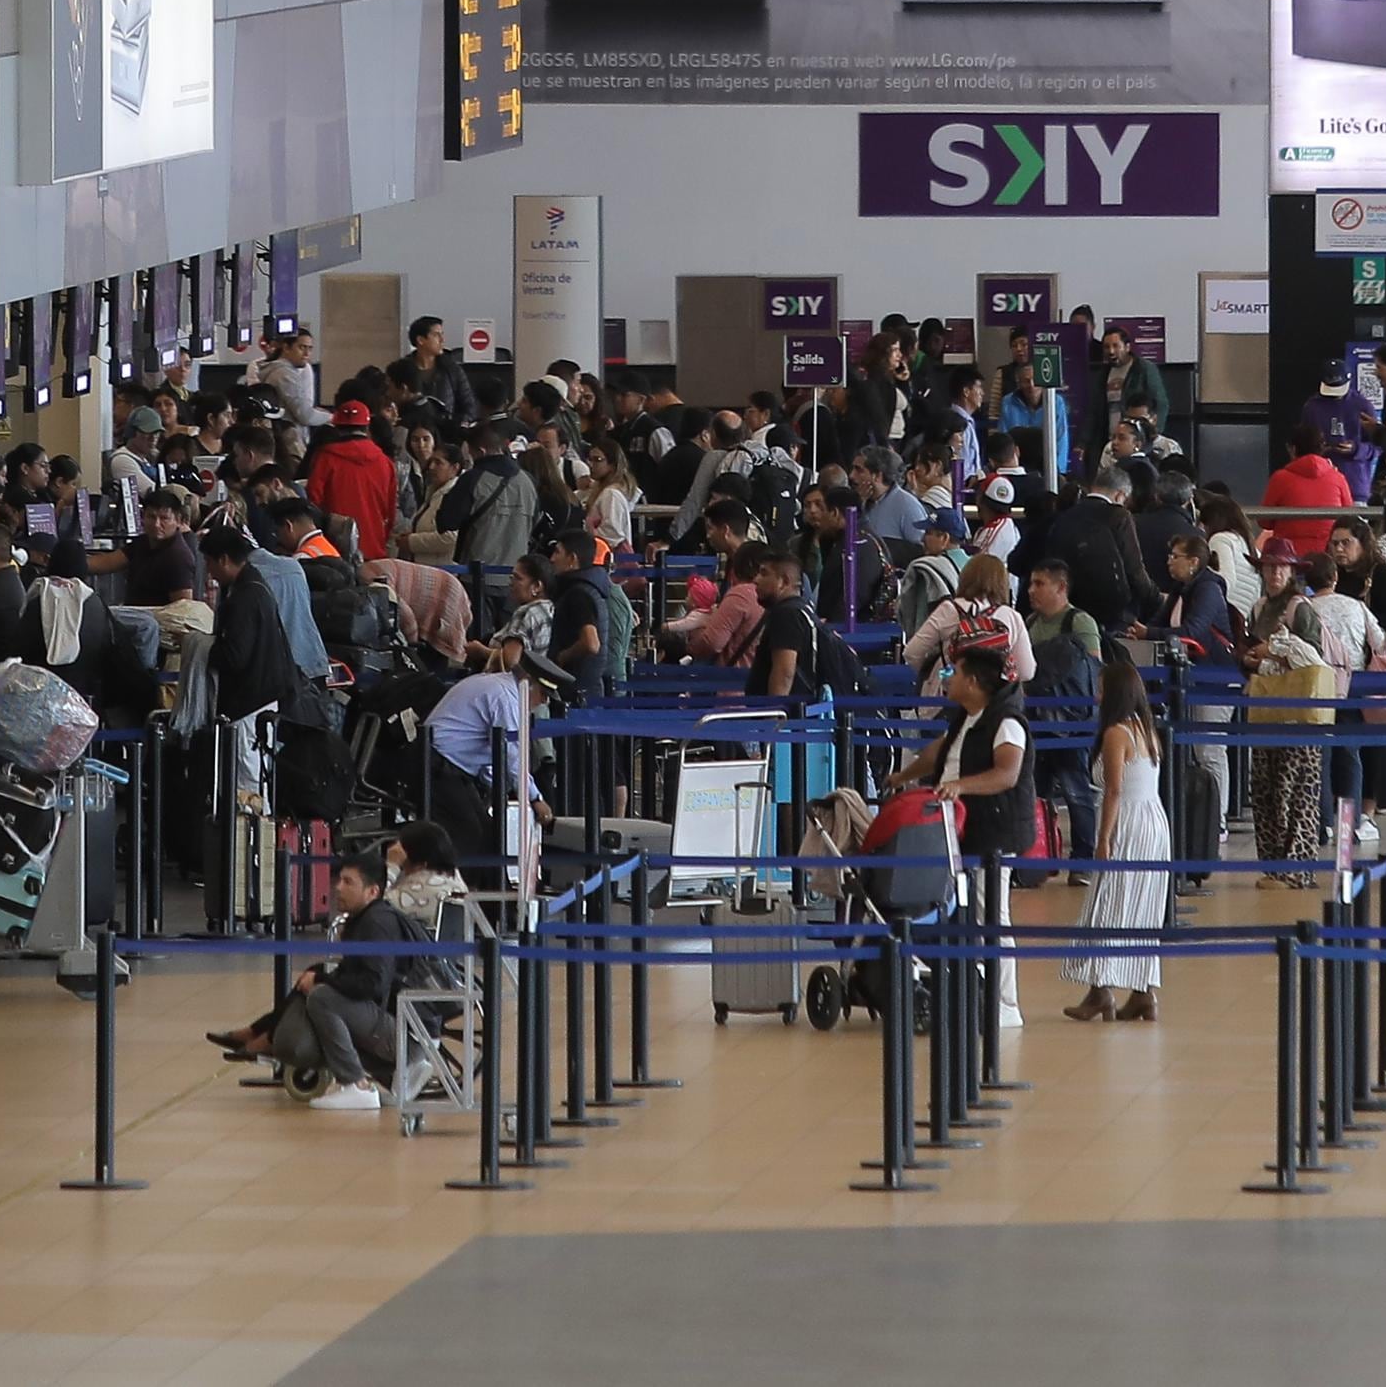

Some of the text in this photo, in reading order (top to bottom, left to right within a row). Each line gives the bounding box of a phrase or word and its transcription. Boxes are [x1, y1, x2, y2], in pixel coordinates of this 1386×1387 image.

[767, 57, 784, 68] en
[790, 56, 849, 68] nuestra
[854, 53, 888, 68] web
[890, 53, 1016, 71] www.LG.com/pe
[547, 78, 564, 89] se
[568, 76, 641, 89] muestran
[646, 78, 664, 89] en
[669, 74, 690, 89] las
[696, 74, 769, 92] imágenes
[774, 74, 831, 93] pueden
[836, 75, 880, 89] variar
[884, 74, 930, 93] según
[935, 74, 948, 89] el
[954, 74, 1014, 91] modelo,
[1037, 74, 1086, 93] región
[1092, 78, 1102, 89] o
[1106, 74, 1120, 89] el
[928, 123, 1151, 207] SKY
[530, 240, 579, 250] LATAM
[522, 273, 572, 283] Oficina de
[1362, 260, 1377, 279] S
[522, 286, 555, 295] Ventas
[771, 295, 824, 317] SKY
[992, 293, 1042, 313] SKY
[792, 354, 825, 365] Salida
